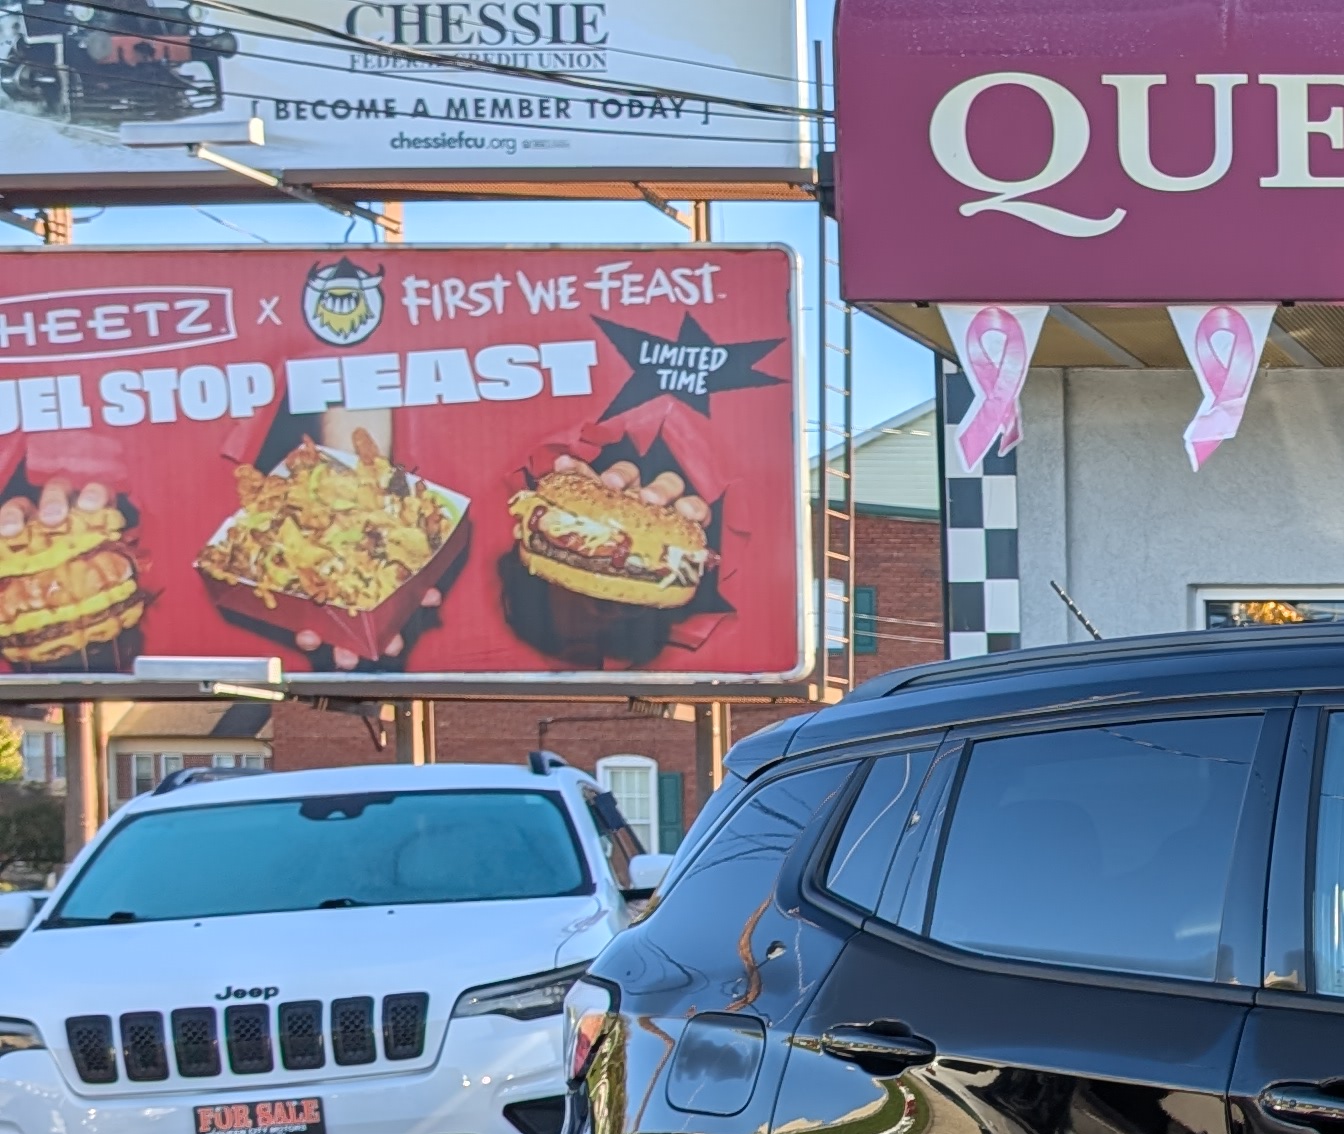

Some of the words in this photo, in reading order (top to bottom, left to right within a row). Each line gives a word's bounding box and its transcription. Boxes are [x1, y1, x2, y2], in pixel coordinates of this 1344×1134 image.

[346, 3, 609, 46] CHESSIE
[350, 52, 446, 71] FEDER
[538, 53, 608, 70] UNION
[275, 98, 397, 121] BECOME
[412, 98, 431, 118] A
[446, 98, 572, 120] MEMBER
[586, 97, 687, 119] TODAY
[390, 131, 517, 155] chessiefcu.org
[402, 272, 512, 326] FIRST
[516, 269, 581, 316] WE
[584, 260, 721, 311] FEAST
[0, 299, 213, 348] HEETZ
[639, 339, 728, 372] LIMITED
[100, 361, 276, 427] STOP
[285, 339, 599, 415] FEAST
[656, 368, 709, 396] TIME
[214, 985, 280, 1001] Jeep
[196, 1103, 254, 1133] FOR
[255, 1098, 321, 1128] SALE
